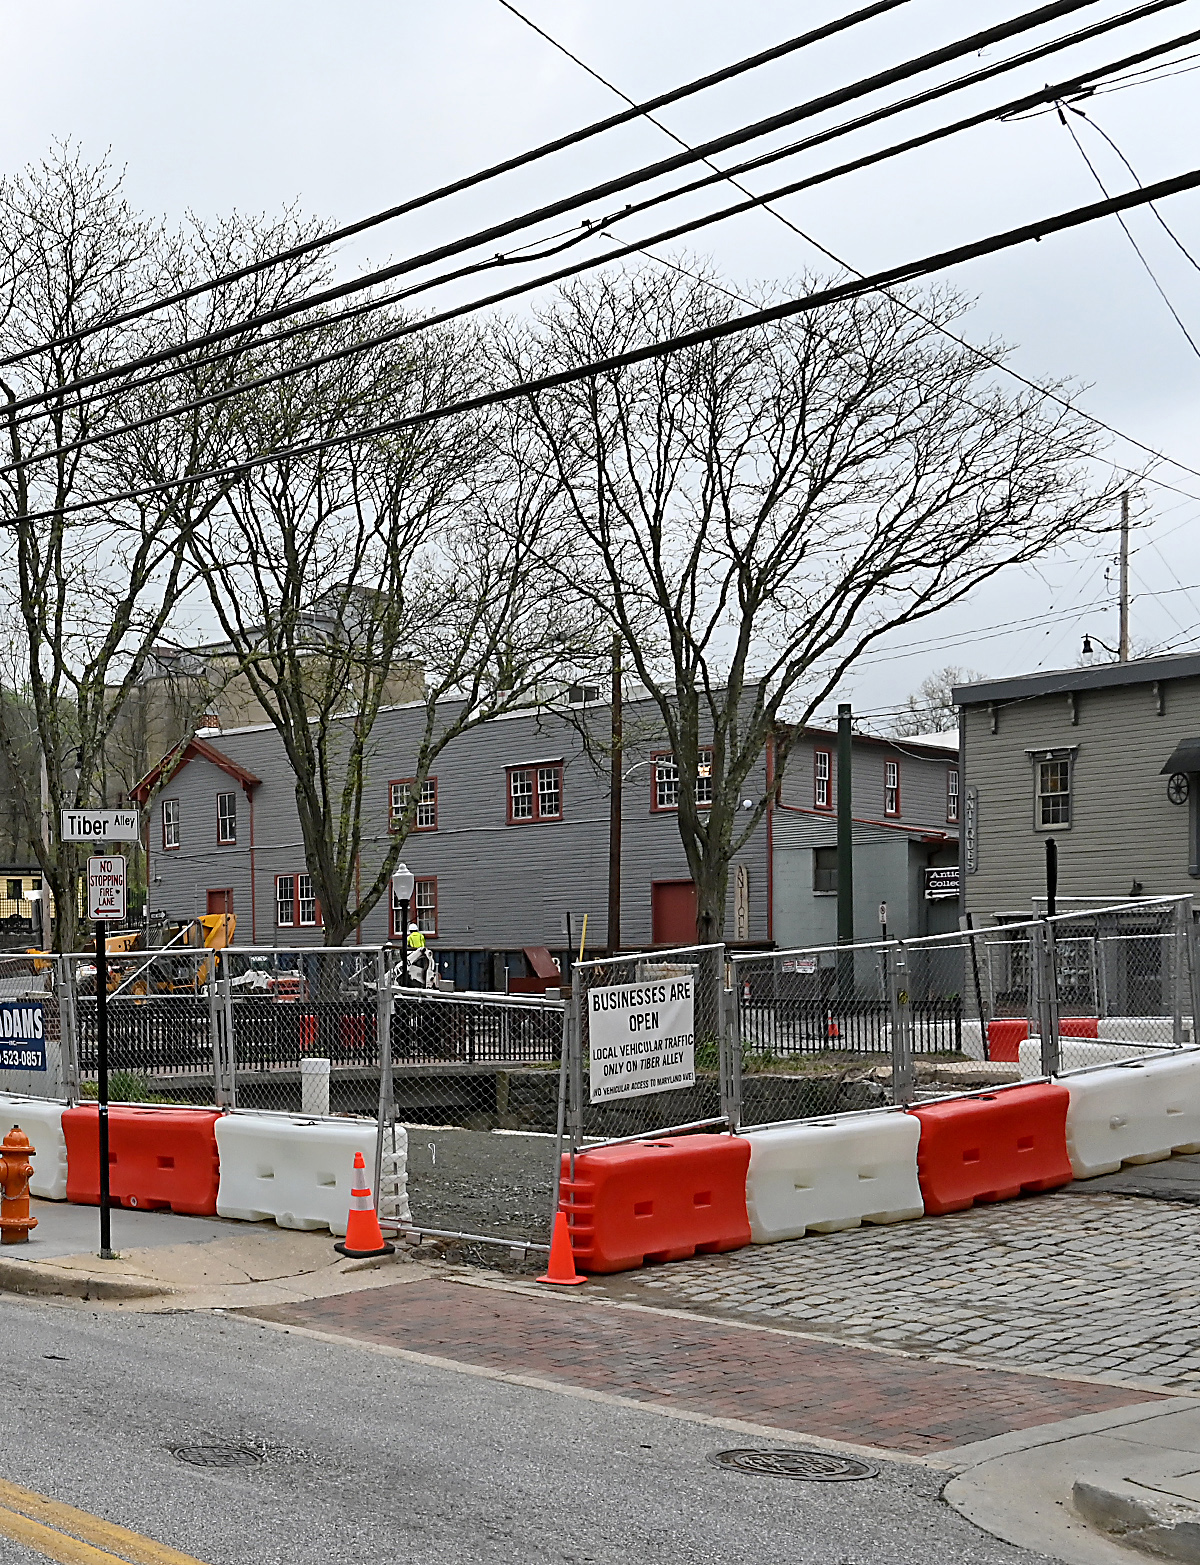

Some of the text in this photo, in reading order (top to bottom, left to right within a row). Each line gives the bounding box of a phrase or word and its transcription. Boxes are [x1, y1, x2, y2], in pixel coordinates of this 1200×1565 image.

[67, 815, 136, 836] Tiber Alley
[966, 790, 975, 869] ANTIQUES
[100, 860, 113, 873] NO
[90, 874, 123, 887] STOPPING
[98, 897, 115, 906] LANE
[99, 888, 114, 897] FIRE
[592, 982, 691, 1012] BUSINESSES ARE
[629, 1011, 659, 1032] OPEN
[592, 1033, 694, 1061] LOCAL VEHICULAR TRAFFIC
[603, 1051, 684, 1077] ONLY ON TIBER ALLEY
[602, 1083, 630, 1096] VEHICULAR
[630, 1079, 649, 1090] ACCESS
[650, 1078, 656, 1087] TO
[657, 1074, 682, 1086] MARYLAND
